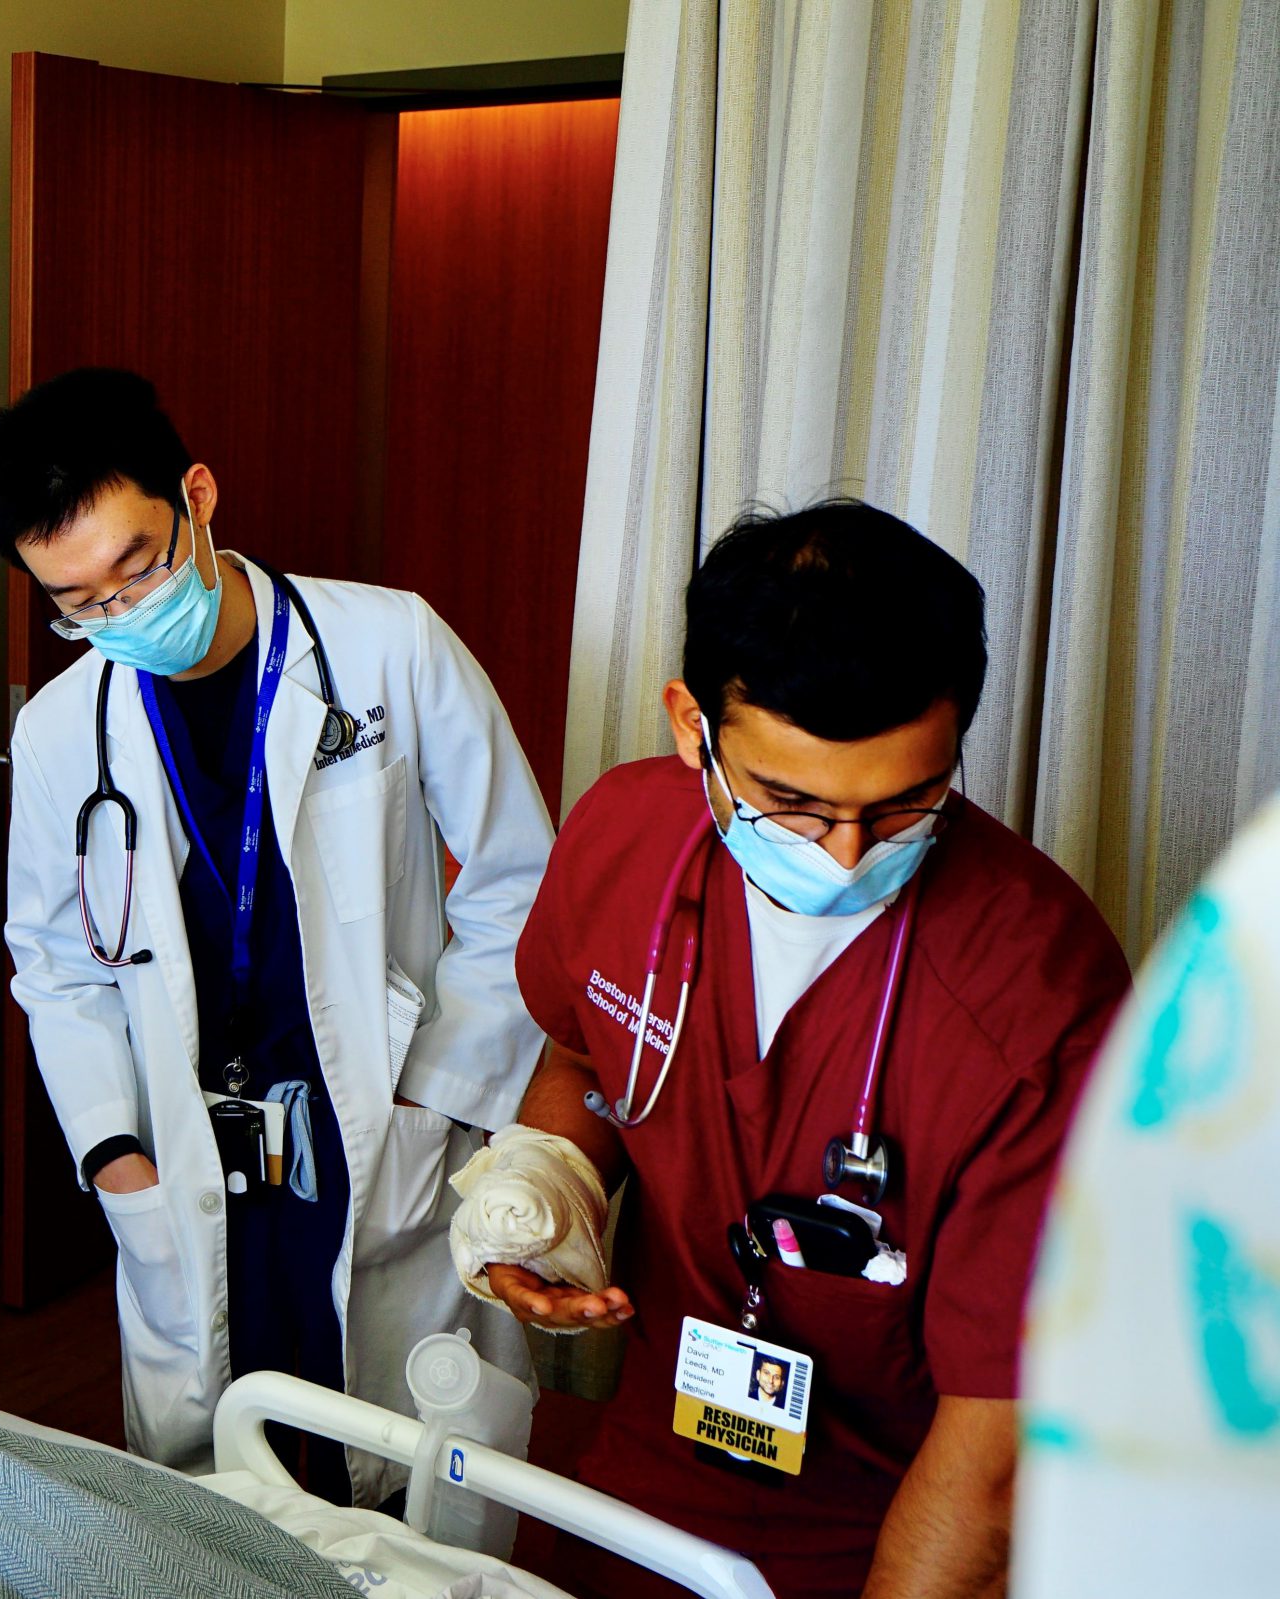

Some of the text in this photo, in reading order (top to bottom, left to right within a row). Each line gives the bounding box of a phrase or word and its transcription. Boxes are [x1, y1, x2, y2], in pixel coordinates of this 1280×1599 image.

[366, 705, 385, 724] MD
[590, 969, 674, 1040] Boston Uniersity
[587, 985, 671, 1054] School of Mdicine
[687, 1346, 709, 1359] David
[684, 1370, 714, 1386] Resident
[712, 1366, 724, 1376] MD
[682, 1381, 715, 1398] Medicine
[703, 1405, 776, 1442] RESIDENT
[697, 1420, 779, 1461] PHYSICIAN
